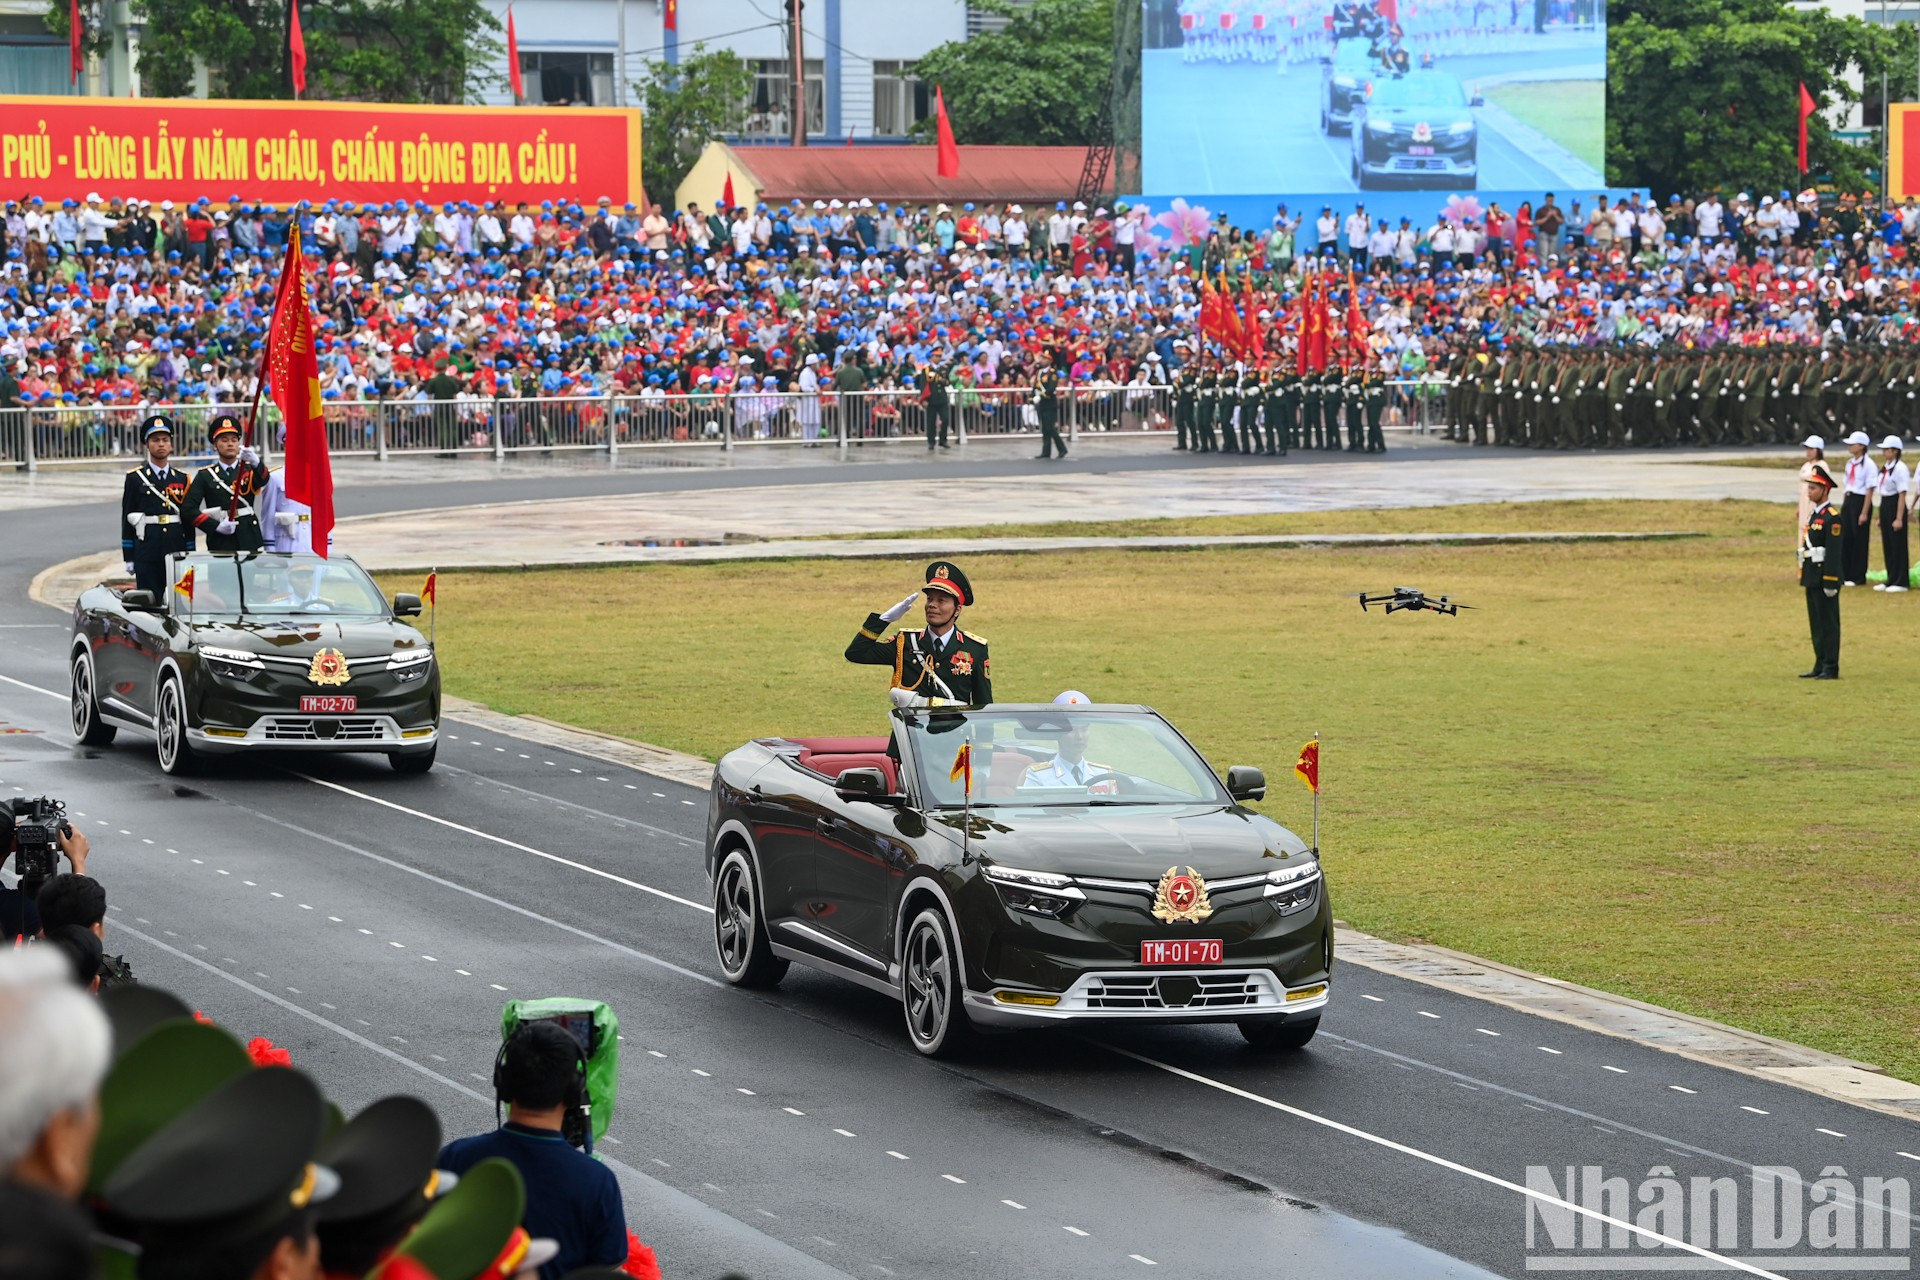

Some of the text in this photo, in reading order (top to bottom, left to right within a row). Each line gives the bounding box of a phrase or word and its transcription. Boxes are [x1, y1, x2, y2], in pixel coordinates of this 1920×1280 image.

[2, 119, 52, 179] PHỦ
[73, 125, 137, 180] LỪNG
[142, 119, 187, 181] LẪY
[192, 128, 249, 181] NĂM
[254, 129, 326, 187] CHÂU,
[331, 125, 396, 183] CHẤN
[400, 132, 467, 193] ĐỘNG
[471, 142, 514, 194] ĐỊA
[302, 697, 355, 711] TM-02-70
[1143, 942, 1221, 963] TM-01-70
